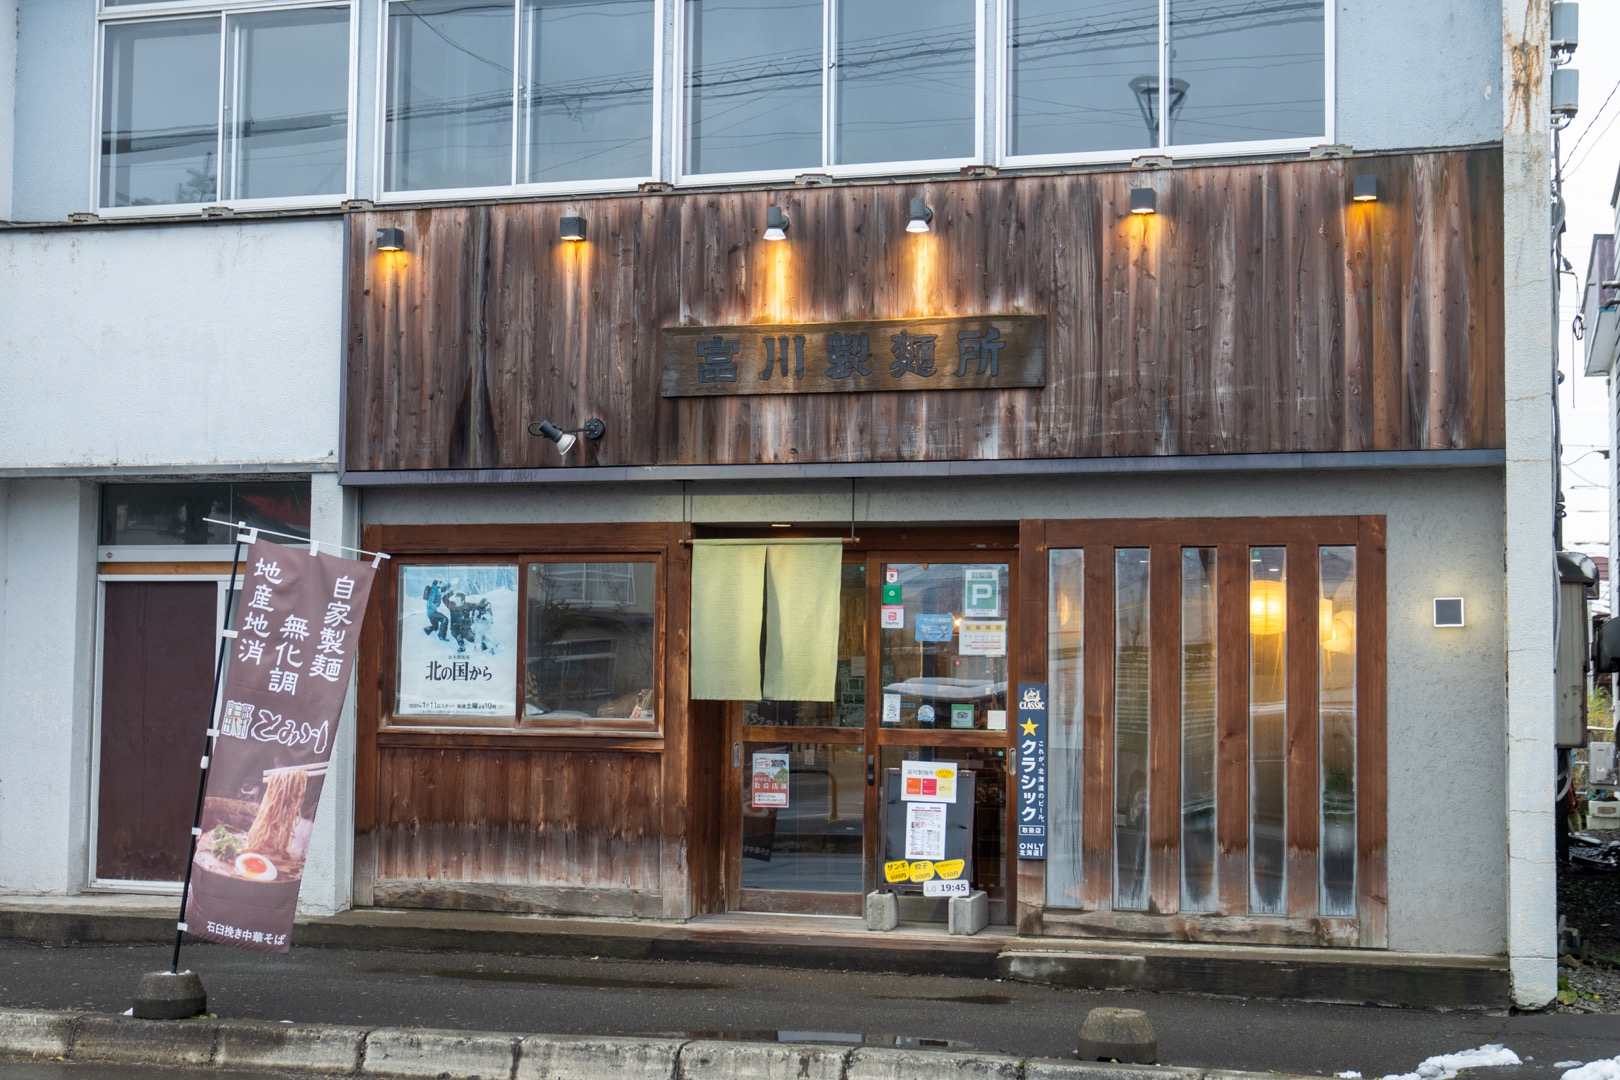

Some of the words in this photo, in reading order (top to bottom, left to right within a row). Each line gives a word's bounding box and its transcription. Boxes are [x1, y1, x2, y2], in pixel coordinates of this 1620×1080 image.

[971, 584, 992, 605] P
[238, 557, 283, 666] 地産地消
[309, 575, 355, 682] 自家製麺
[268, 614, 310, 696] 無化調
[425, 660, 492, 681] 北の国から
[1019, 701, 1045, 710] CLASSIC
[1021, 739, 1037, 822] クラシック
[1019, 842, 1044, 850] ONLY
[887, 862, 907, 870] ザンギ
[941, 884, 966, 892] 19:45
[206, 921, 286, 946] 石臼挽き中華そば
